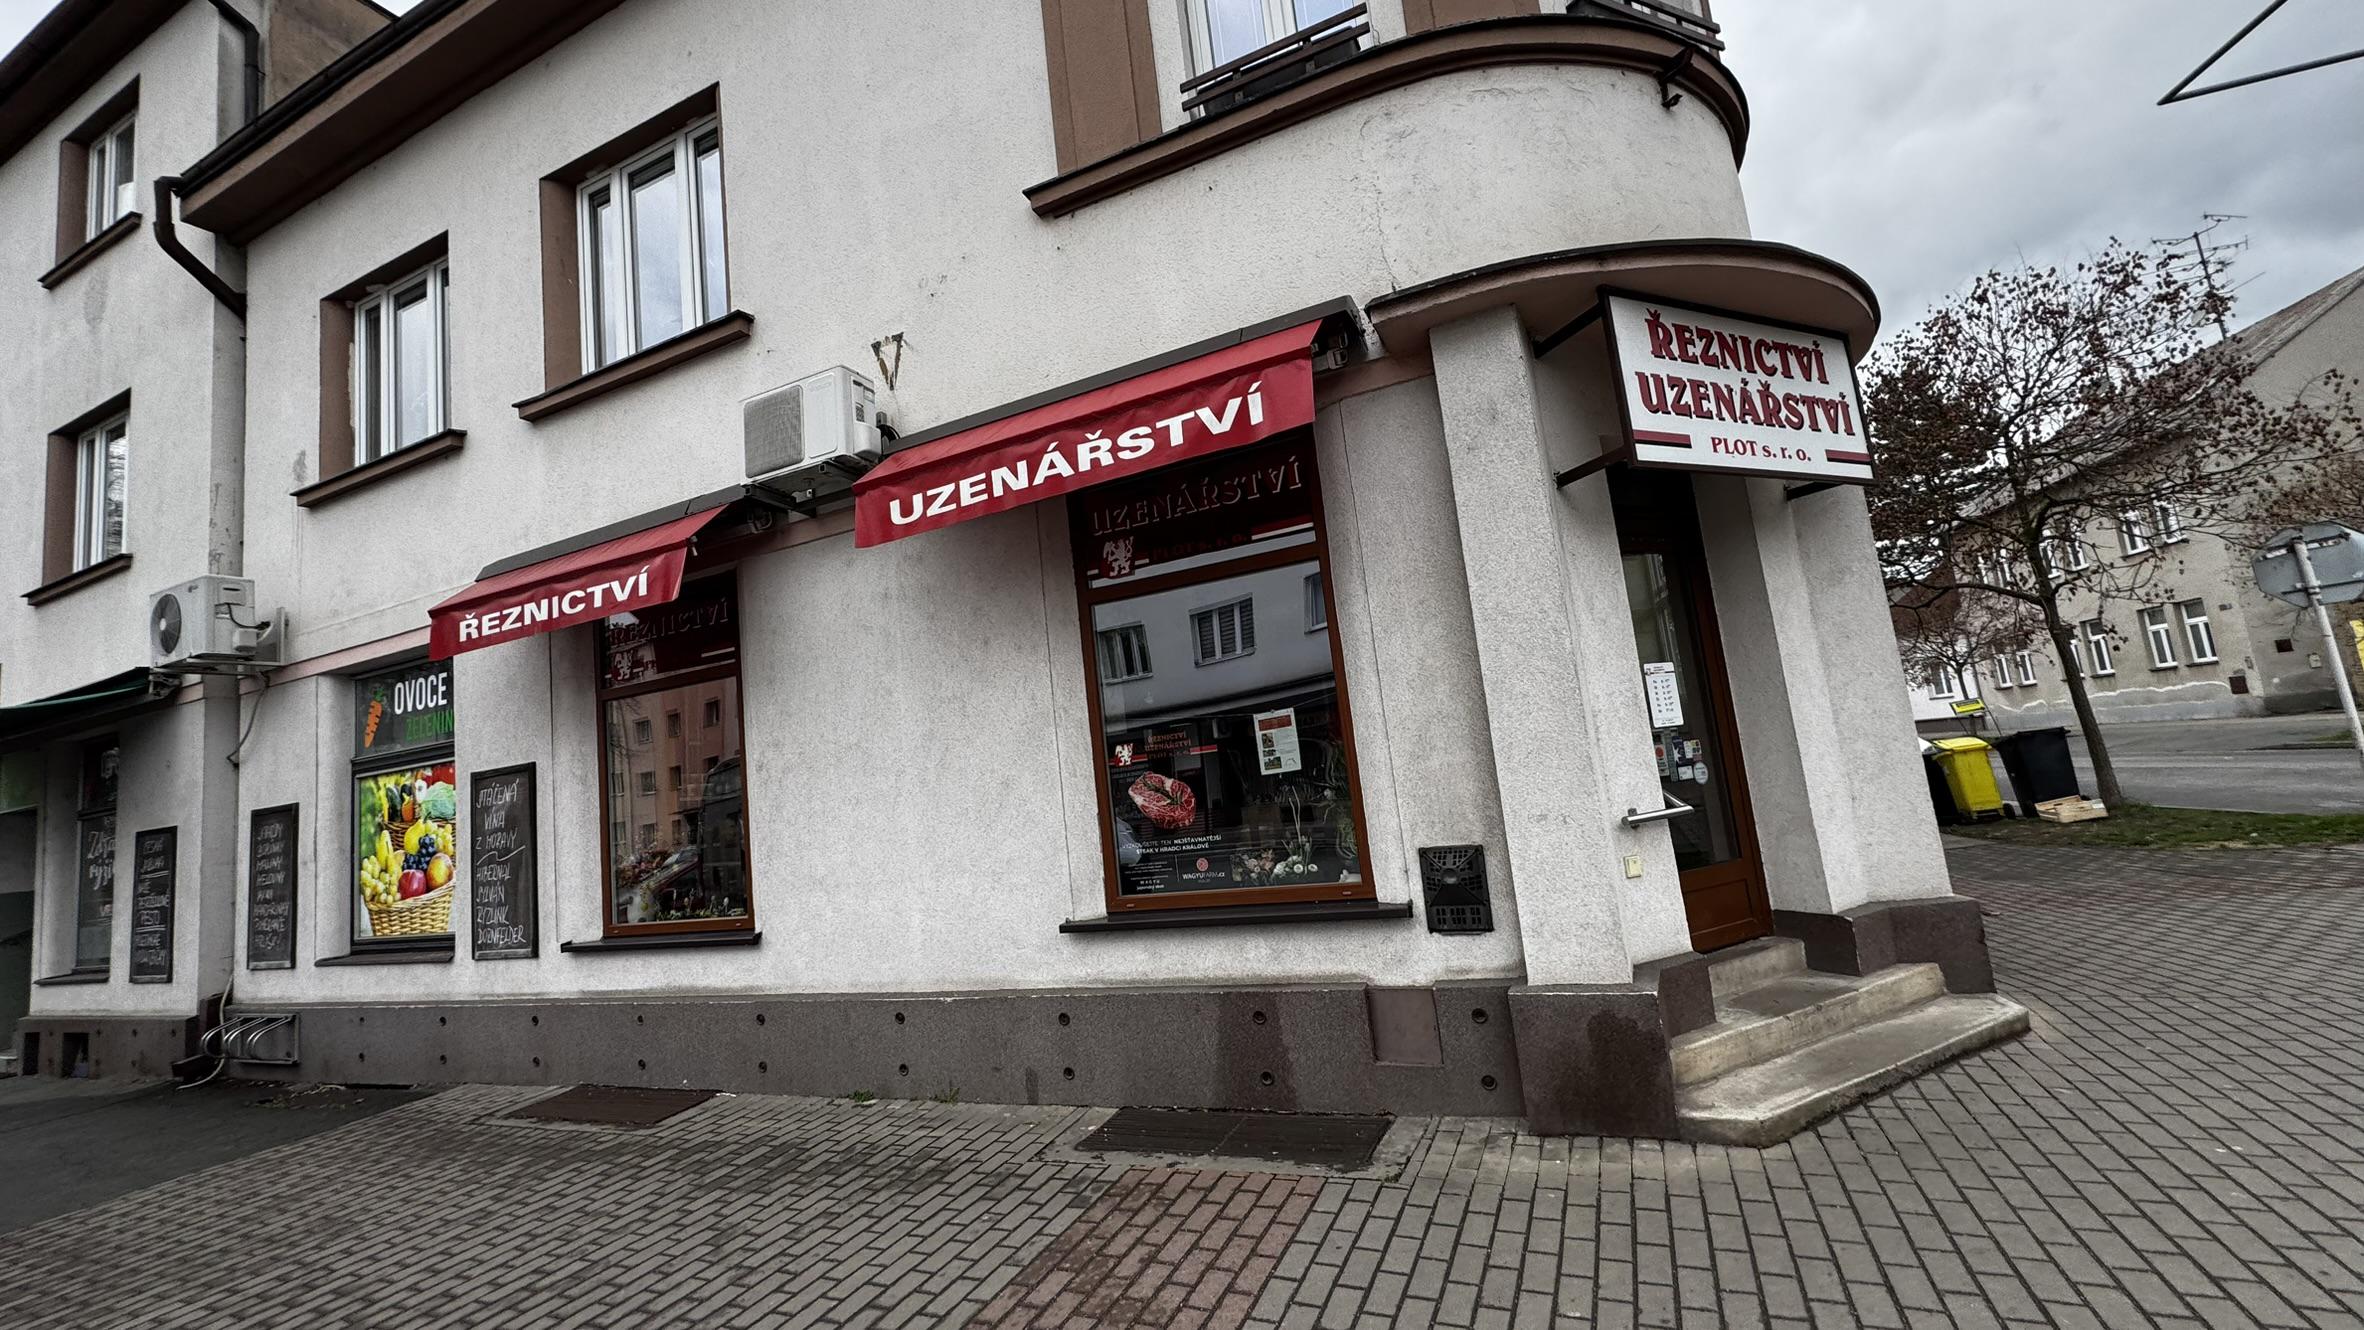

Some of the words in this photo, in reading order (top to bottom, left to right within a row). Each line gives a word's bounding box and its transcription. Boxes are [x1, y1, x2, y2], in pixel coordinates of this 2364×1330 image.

[1645, 308, 1829, 385] ŘEZNICTVÍ
[1635, 371, 1856, 436] UZENÁŘSTVÍ
[888, 380, 1265, 526] UZENÁŘSTVÍ
[1711, 437, 1757, 456] PLOT
[1762, 445, 1777, 458] s.
[1780, 446, 1793, 459] r.
[1796, 449, 1812, 461] o.
[1094, 456, 1302, 536] UZENÁŘSTVÍ
[458, 564, 650, 643] ŘEZNICTVÍ
[394, 672, 448, 715] OVOCE
